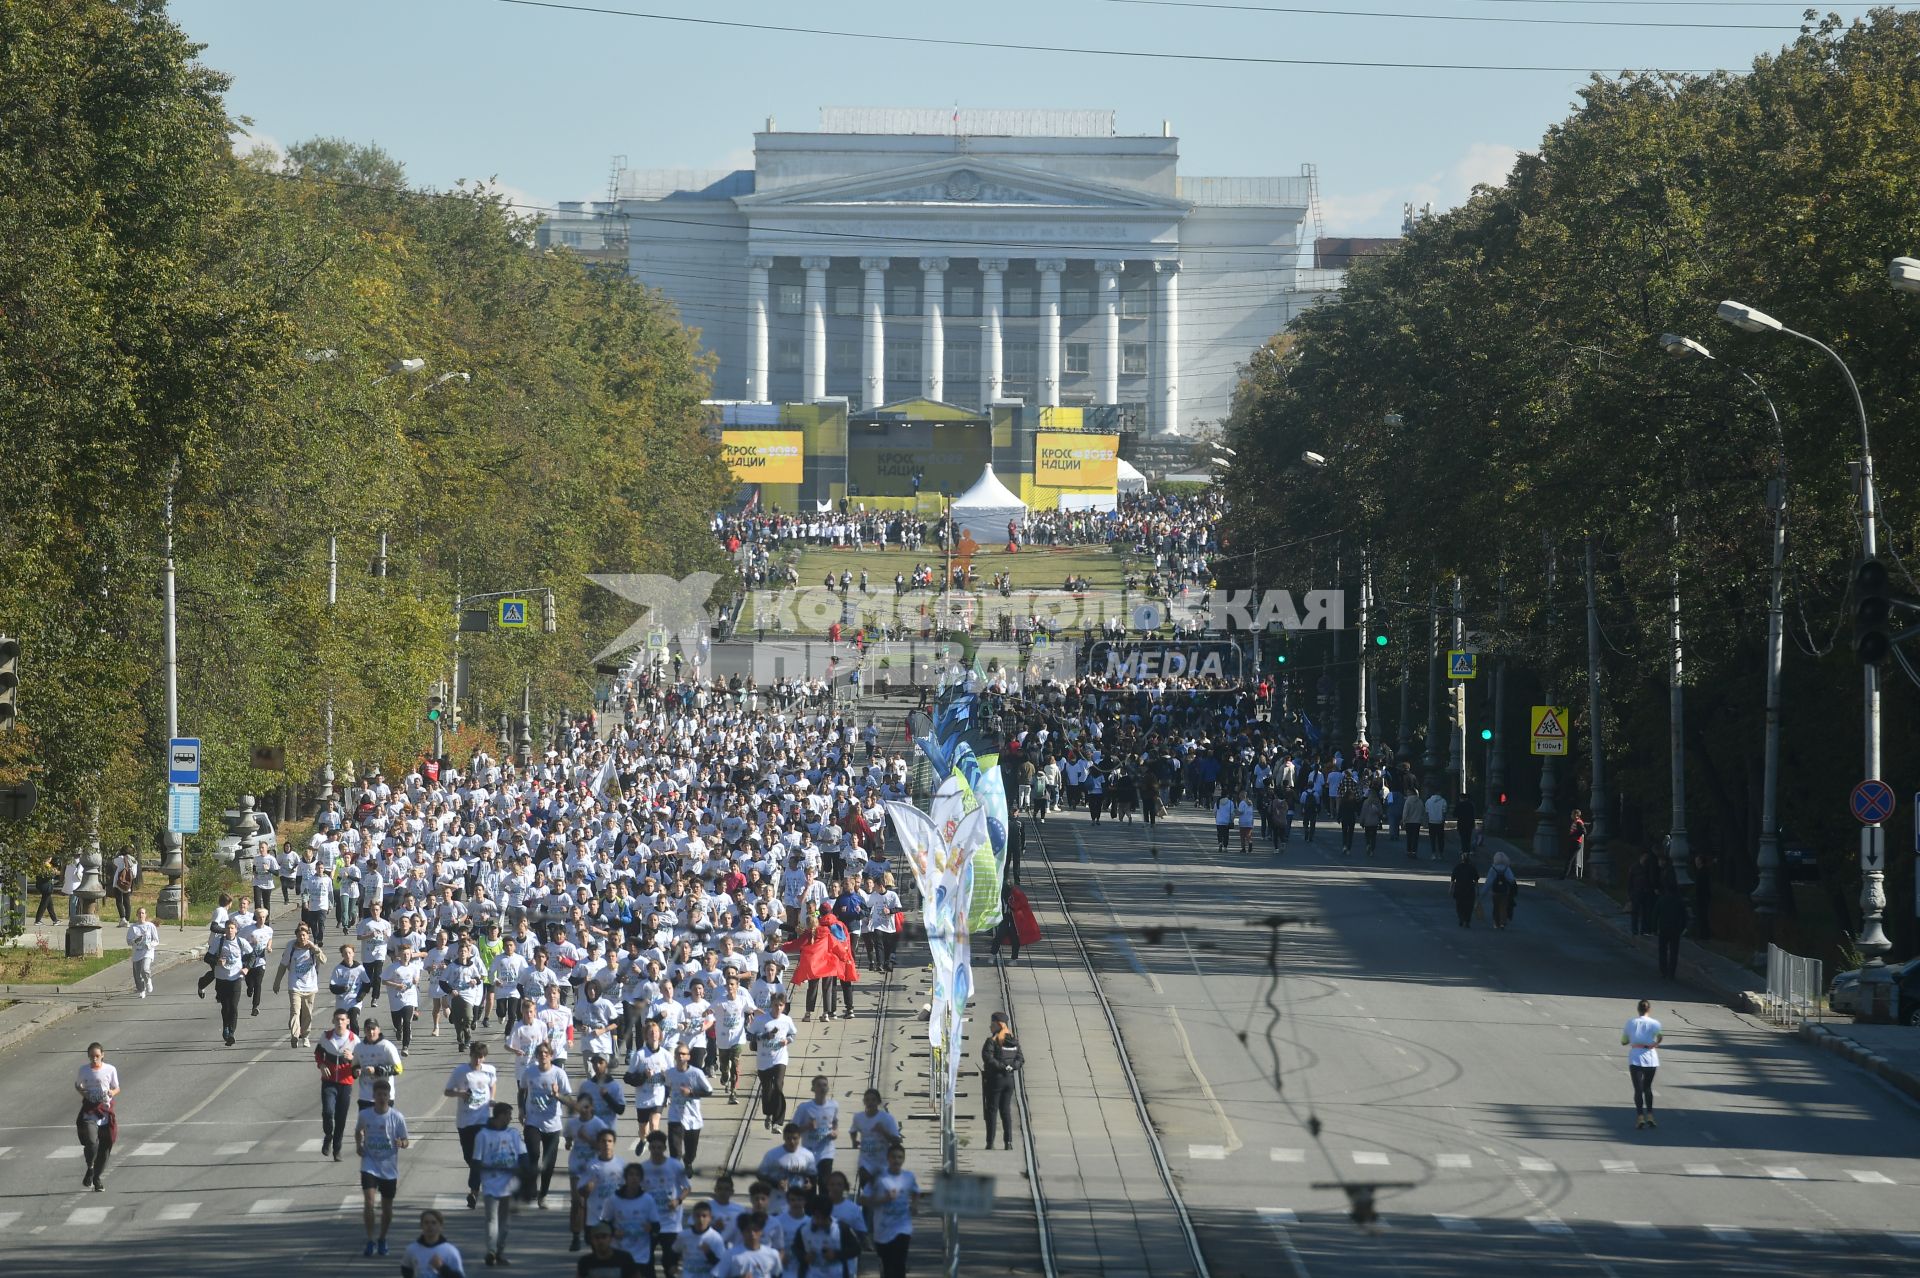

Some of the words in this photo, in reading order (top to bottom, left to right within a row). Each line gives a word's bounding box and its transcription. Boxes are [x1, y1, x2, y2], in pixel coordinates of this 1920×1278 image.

[878, 453, 914, 465] КРОСС
[1041, 448, 1073, 459] КРОСС
[727, 457, 766, 468] НАЦИИ
[1041, 460, 1081, 471] НАЦИИ
[878, 465, 925, 477] НАЦИИ
